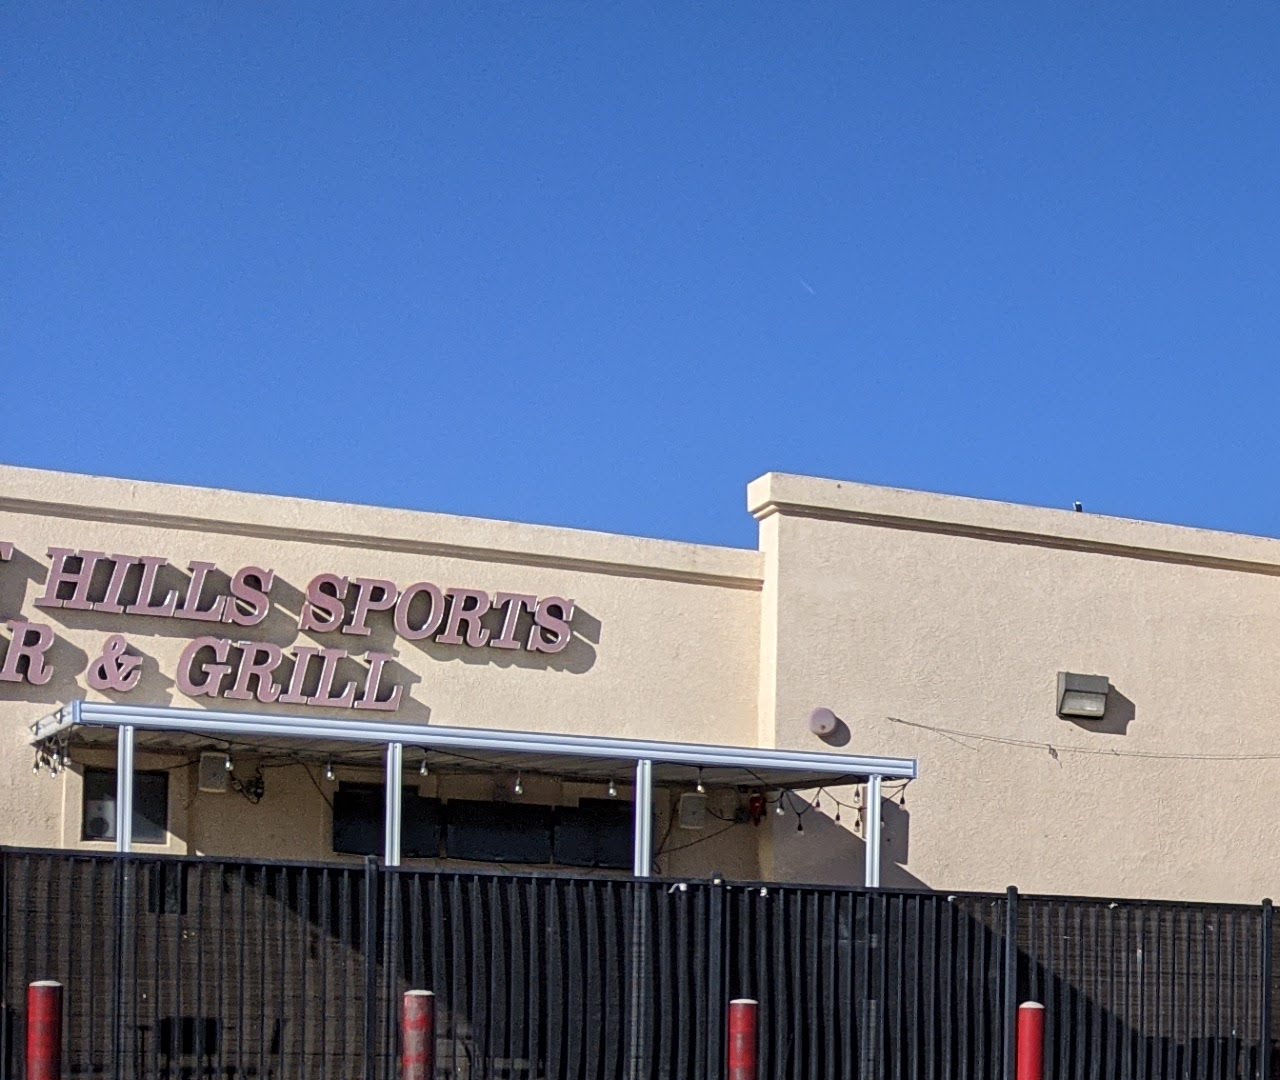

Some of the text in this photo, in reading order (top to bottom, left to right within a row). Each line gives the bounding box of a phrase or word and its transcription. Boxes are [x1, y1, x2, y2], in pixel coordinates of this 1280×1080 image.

[34, 546, 576, 654] HILLS SPORTS
[86, 634, 144, 692] &
[175, 635, 403, 712] GRILL
